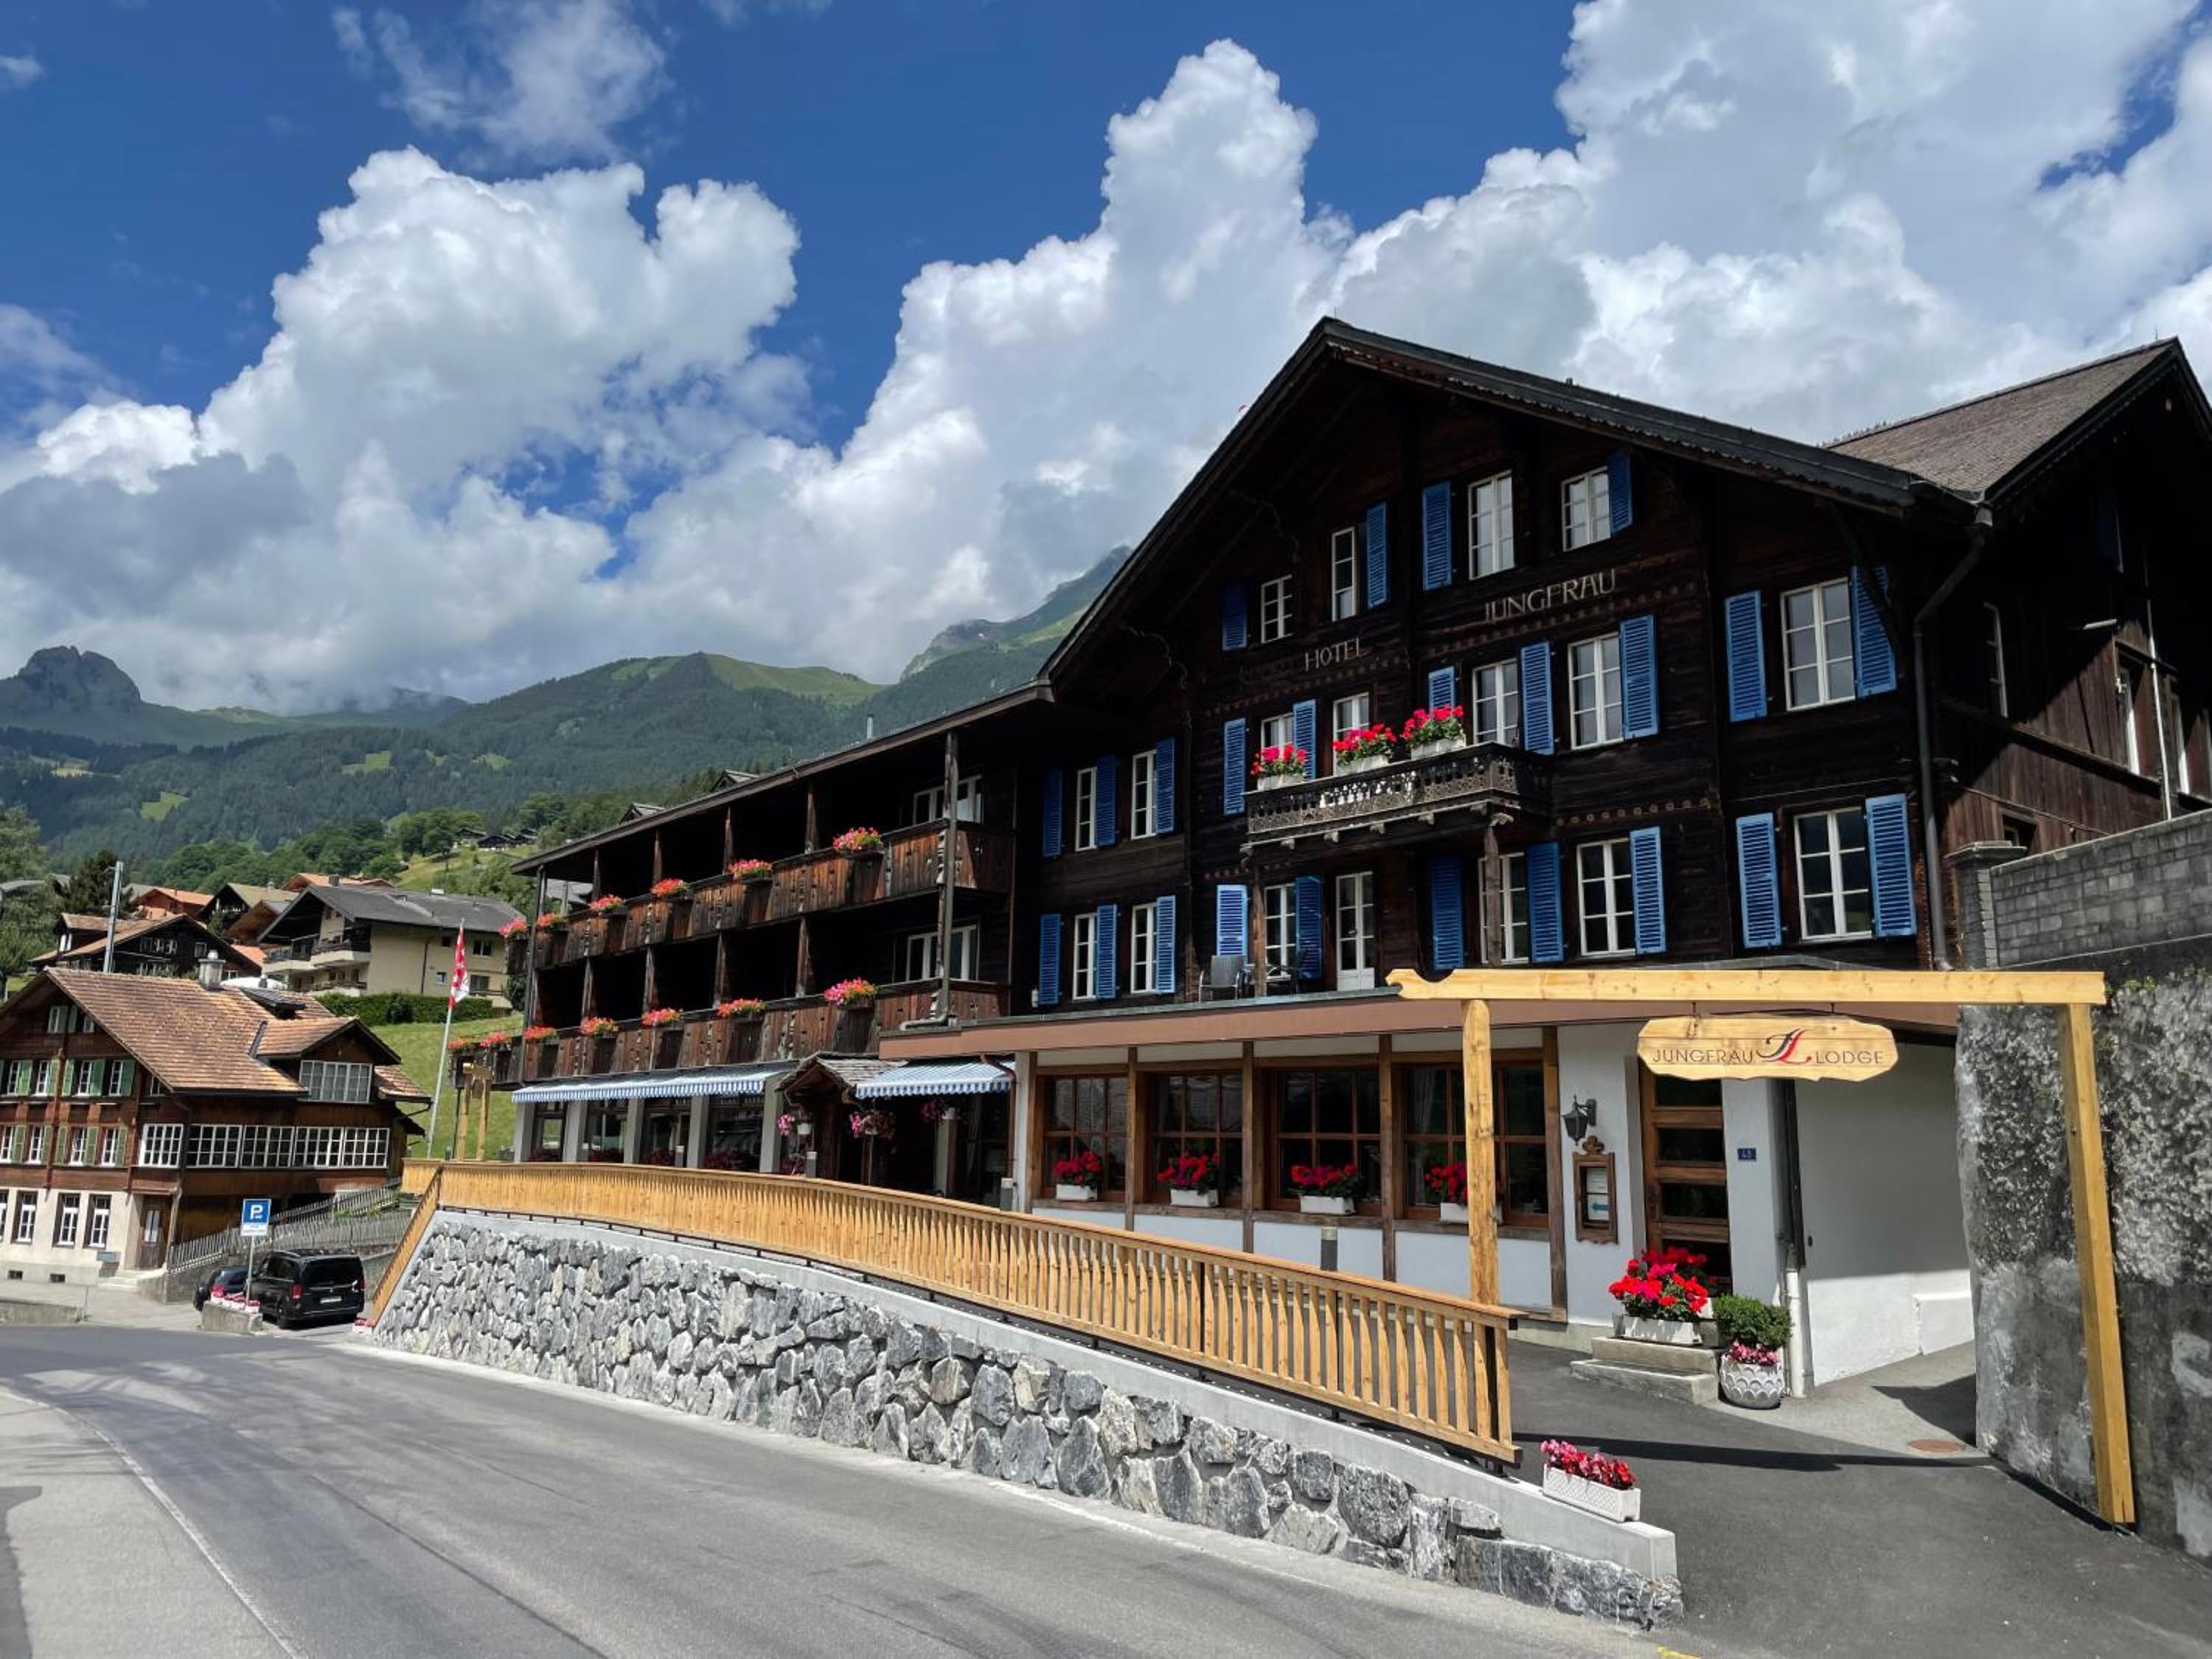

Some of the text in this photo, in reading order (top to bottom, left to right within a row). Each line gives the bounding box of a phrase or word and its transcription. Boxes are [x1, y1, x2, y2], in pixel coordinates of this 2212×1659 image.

[1485, 568, 1615, 625] JUNGFRAU
[1304, 636, 1363, 672] HOTEL
[1652, 1049, 1753, 1064] JUNGFRAU
[1815, 1051, 1884, 1064] LODGE
